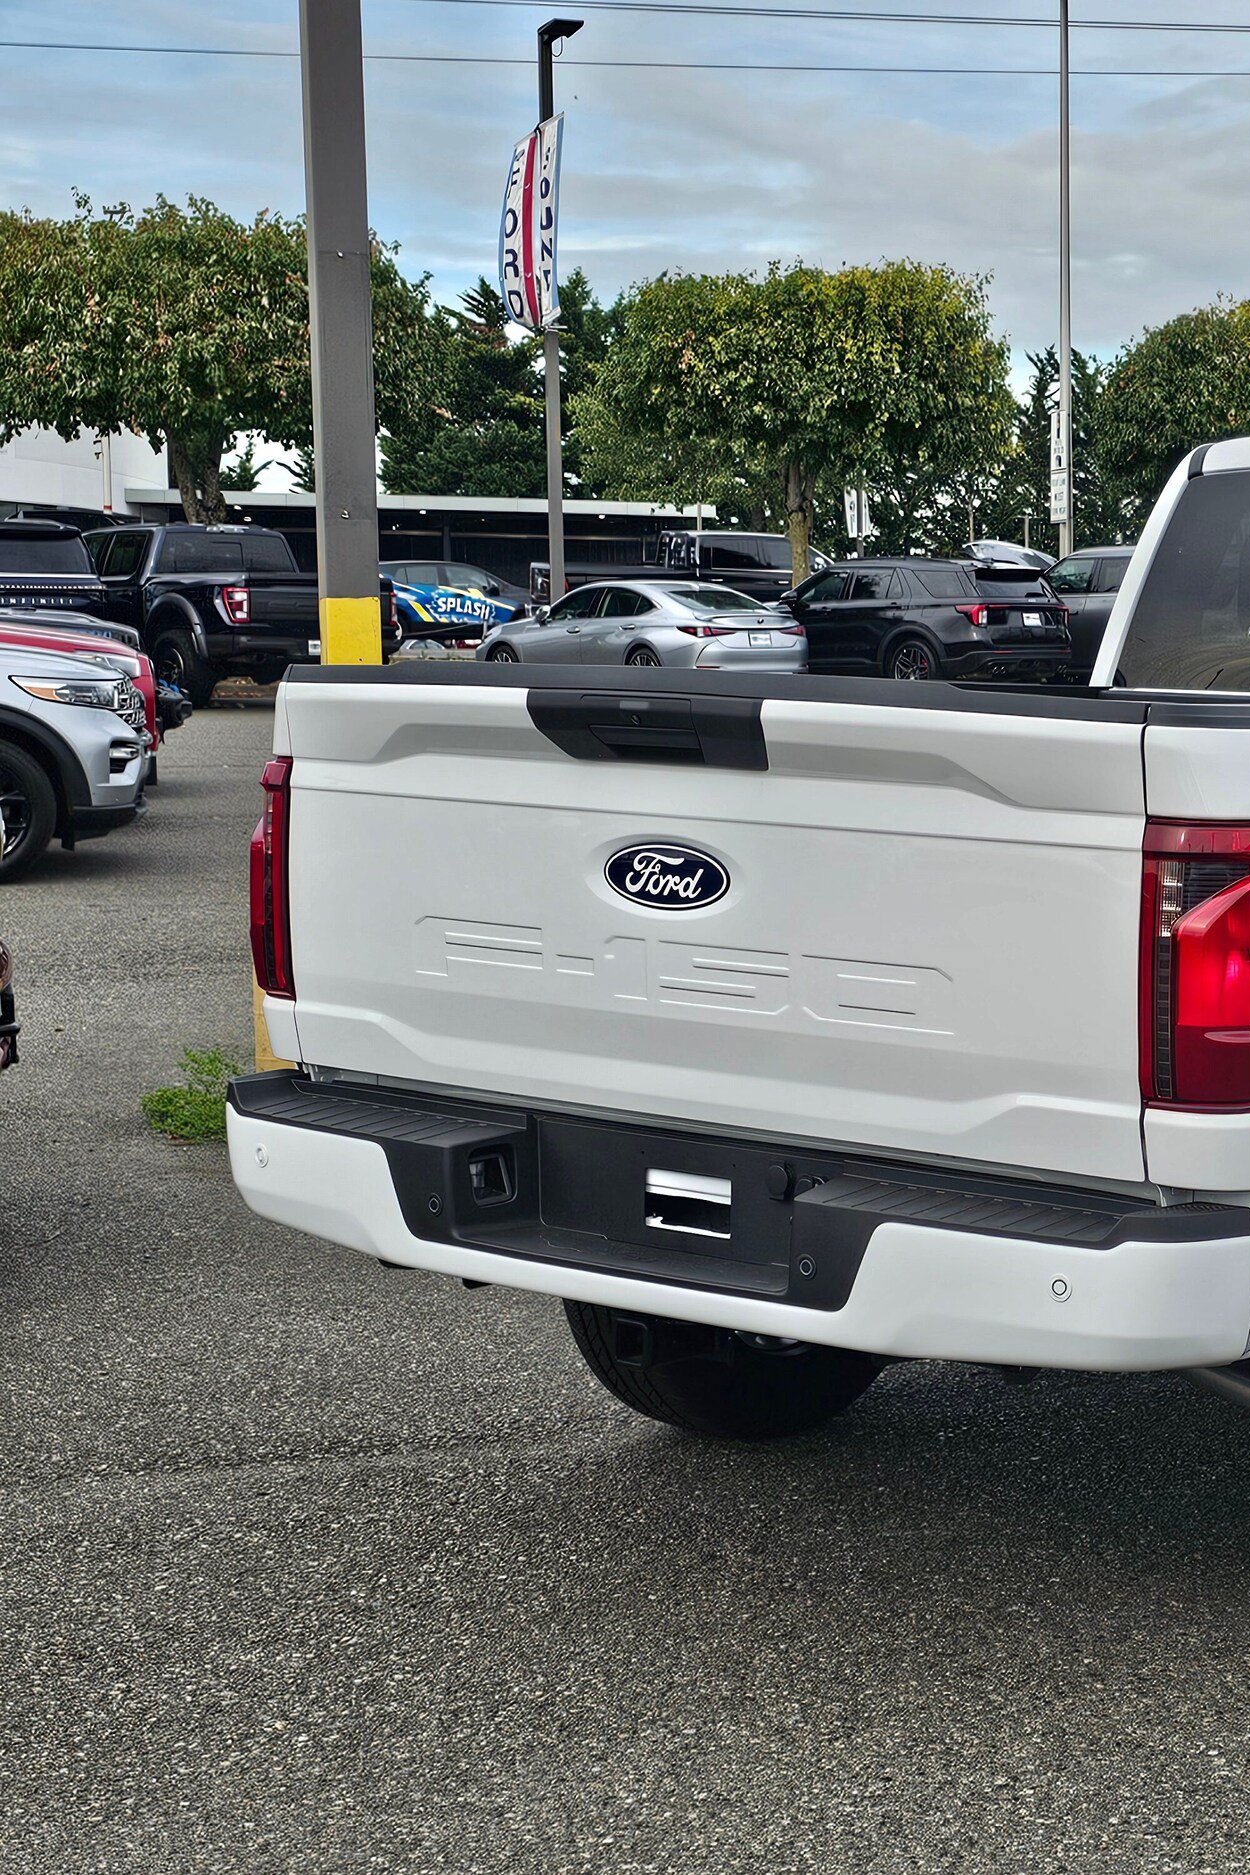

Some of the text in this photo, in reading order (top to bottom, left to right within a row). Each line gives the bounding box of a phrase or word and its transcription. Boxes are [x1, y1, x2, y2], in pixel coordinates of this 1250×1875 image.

[503, 168, 525, 319] FORD
[436, 597, 491, 621] SPLASH
[625, 851, 704, 899] Ford
[414, 914, 955, 1036] F-150
